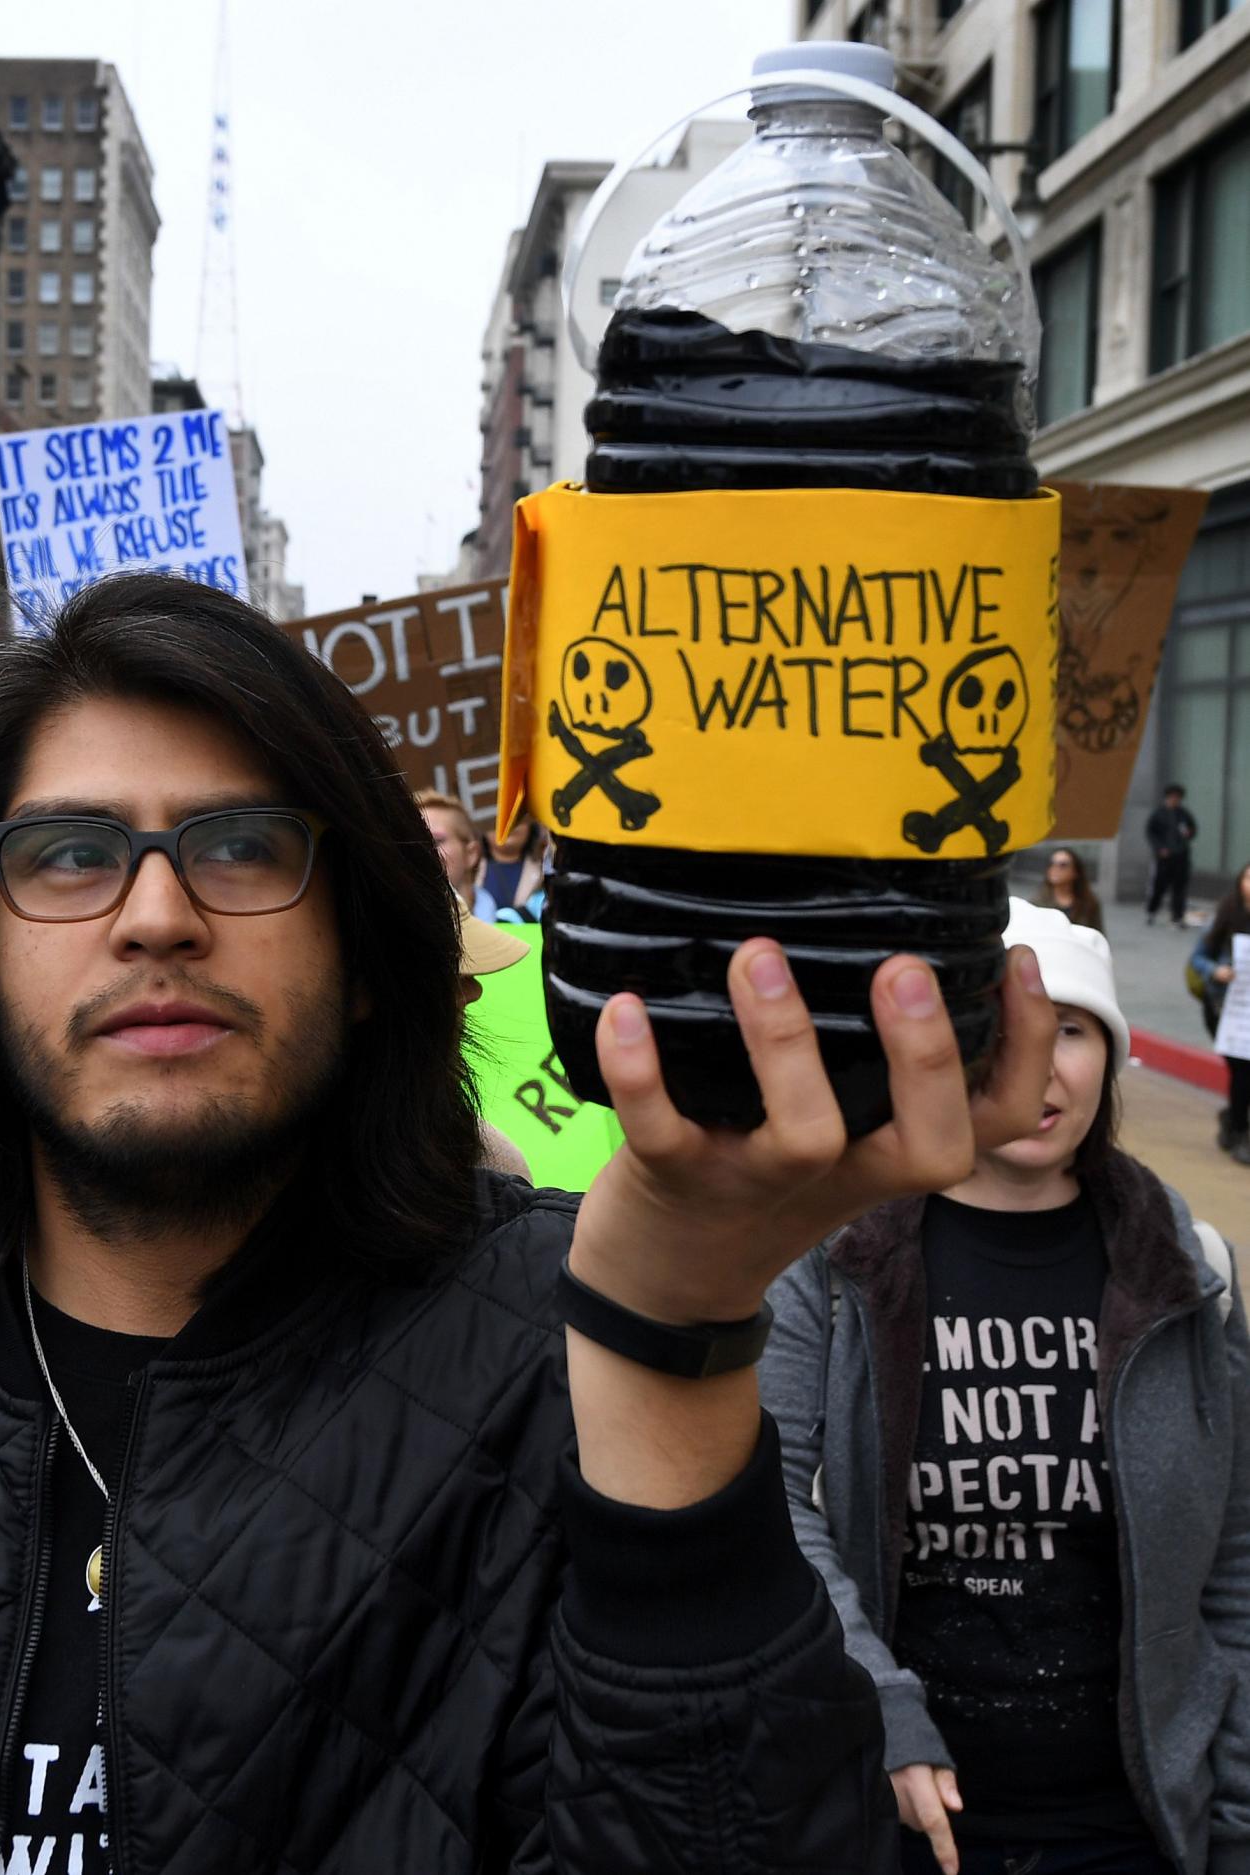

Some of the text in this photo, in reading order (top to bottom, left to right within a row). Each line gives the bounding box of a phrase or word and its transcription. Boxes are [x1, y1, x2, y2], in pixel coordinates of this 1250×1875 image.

[45, 424, 140, 481] SEEMS
[153, 425, 175, 466] 2
[182, 412, 222, 459] ME
[53, 475, 141, 528] ALWAYS
[156, 462, 208, 508] THE
[6, 506, 206, 585] EVIL WE REFUSE
[592, 564, 1005, 648] ALTERNATIVE
[677, 648, 933, 740] WATER
[923, 1316, 1099, 1371] MOCR
[941, 1384, 1057, 1444] NOT
[909, 1454, 1108, 1513] PECTA
[901, 1521, 1068, 1561] PORT
[963, 1577, 1024, 1596] SPEAK
